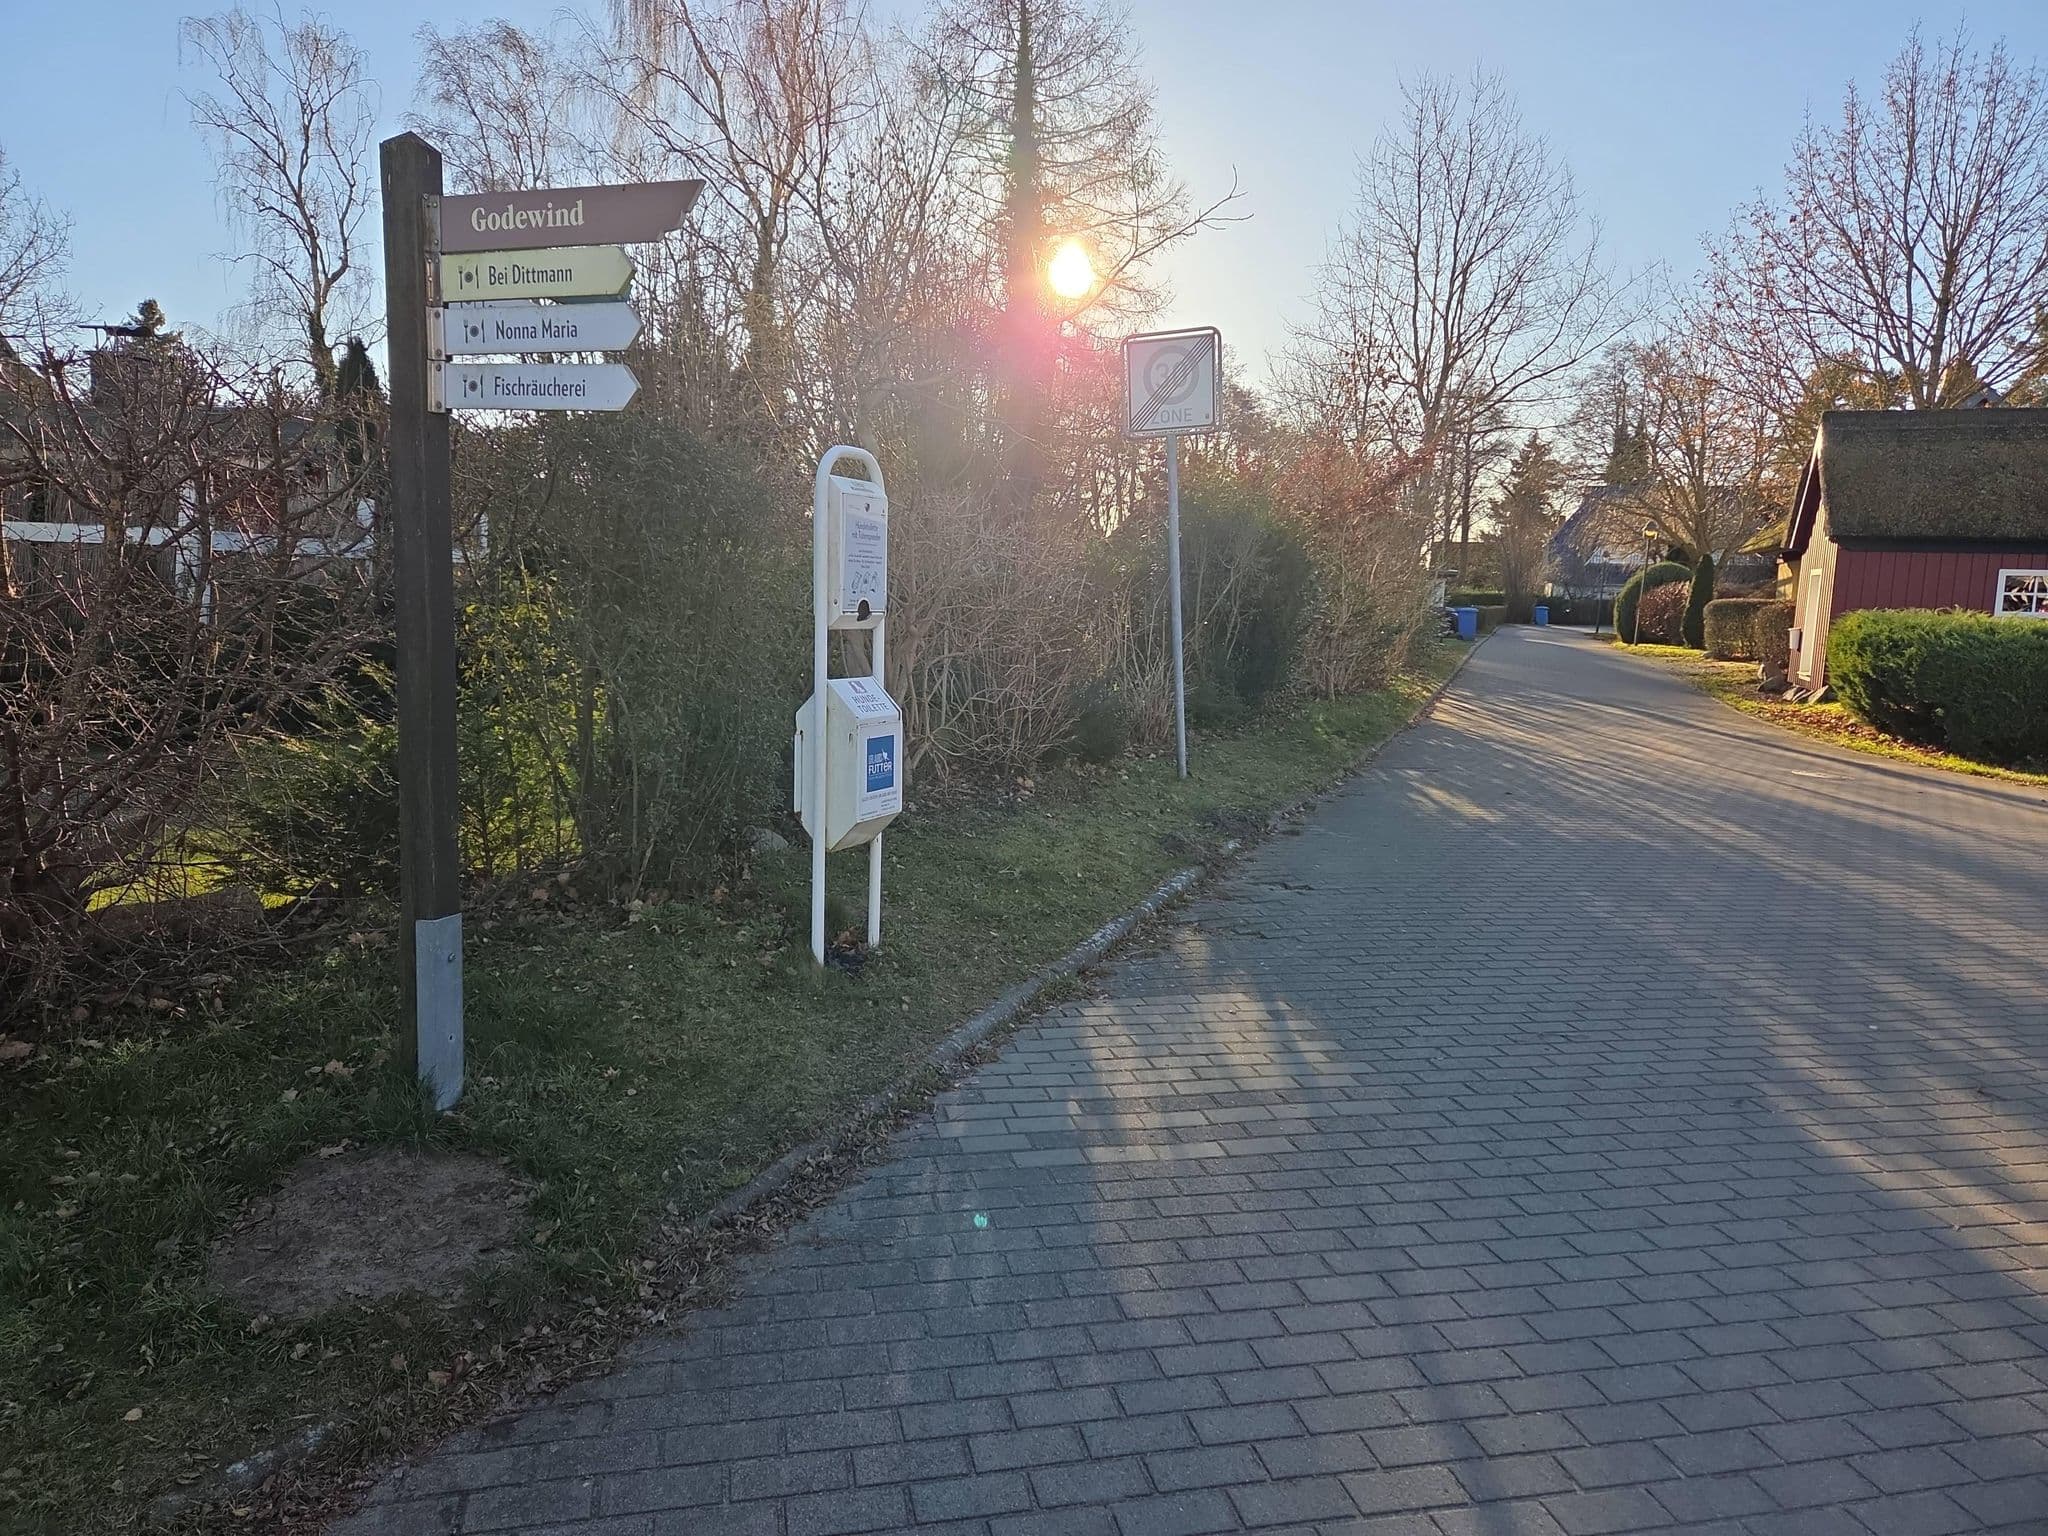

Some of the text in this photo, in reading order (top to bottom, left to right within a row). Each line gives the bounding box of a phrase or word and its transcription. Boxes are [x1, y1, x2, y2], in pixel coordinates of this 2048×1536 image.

[471, 200, 584, 232] Godewind
[488, 264, 573, 286] Bei Dittmann
[495, 319, 577, 340] Nonna Maria
[494, 376, 586, 397] Fischräucherei
[857, 703, 889, 713] TOILETTE
